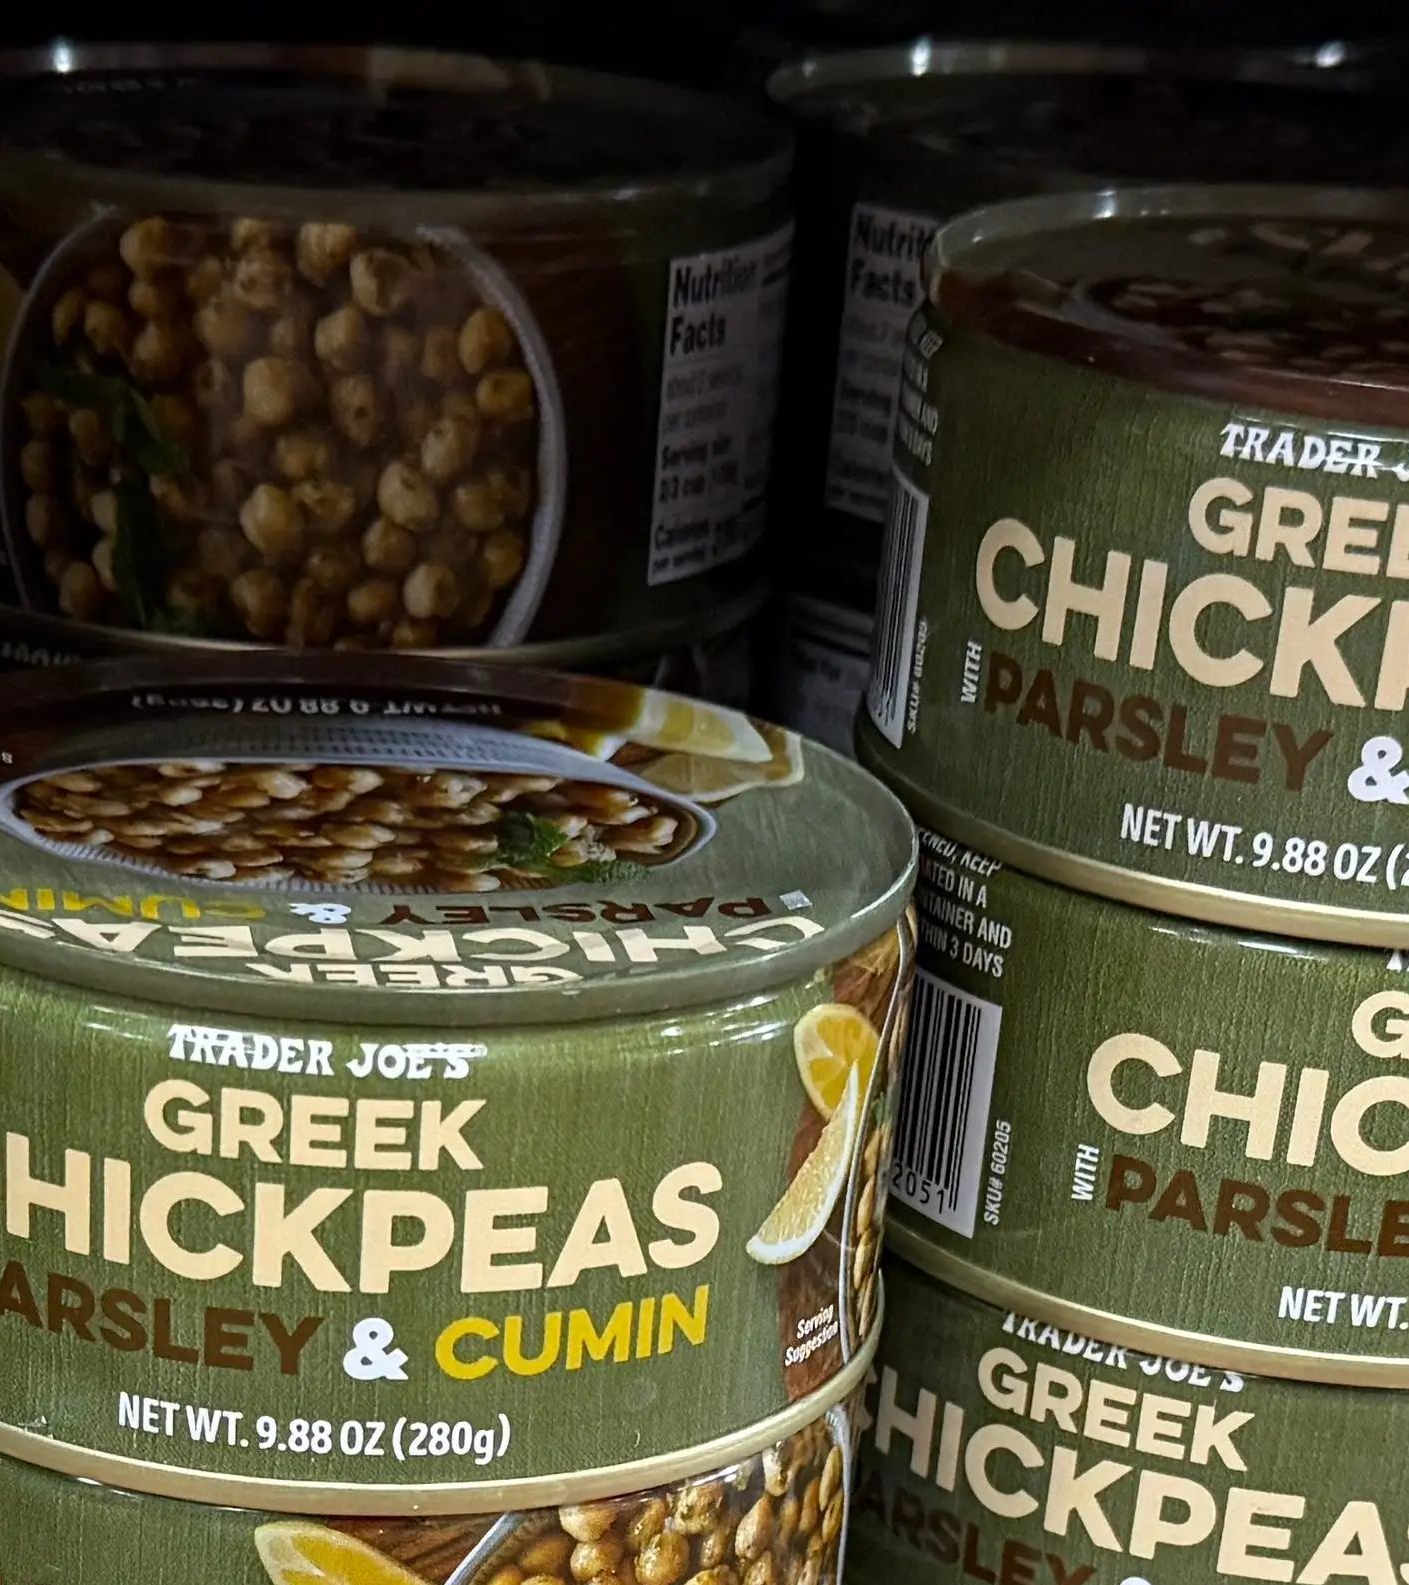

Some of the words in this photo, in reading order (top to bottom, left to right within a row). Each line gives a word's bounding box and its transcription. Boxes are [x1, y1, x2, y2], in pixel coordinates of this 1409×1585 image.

[1219, 422, 1383, 478] TRADER
[960, 639, 983, 703] WITH
[983, 651, 1335, 793] PARSLEY
[1120, 802, 1182, 850] NET
[1187, 817, 1244, 867] WT.
[1252, 831, 1328, 875] 9.88
[1333, 843, 1382, 890] OZ
[963, 942, 1004, 978] DAYS
[977, 916, 1012, 949] AND
[168, 1023, 335, 1077] TRADER
[143, 1078, 488, 1171] GREEK
[1071, 1143, 1100, 1203] WITH
[342, 1317, 409, 1381] &
[434, 1284, 710, 1379] CUMIN
[1277, 1285, 1346, 1326] NET
[1349, 1295, 1409, 1331] WT.
[117, 1390, 181, 1436] NET
[185, 1405, 249, 1449] WT.
[256, 1414, 332, 1456] 9.88
[340, 1420, 387, 1456] OZ
[393, 1413, 511, 1466] (280g)
[978, 1346, 1256, 1473] GREEK
